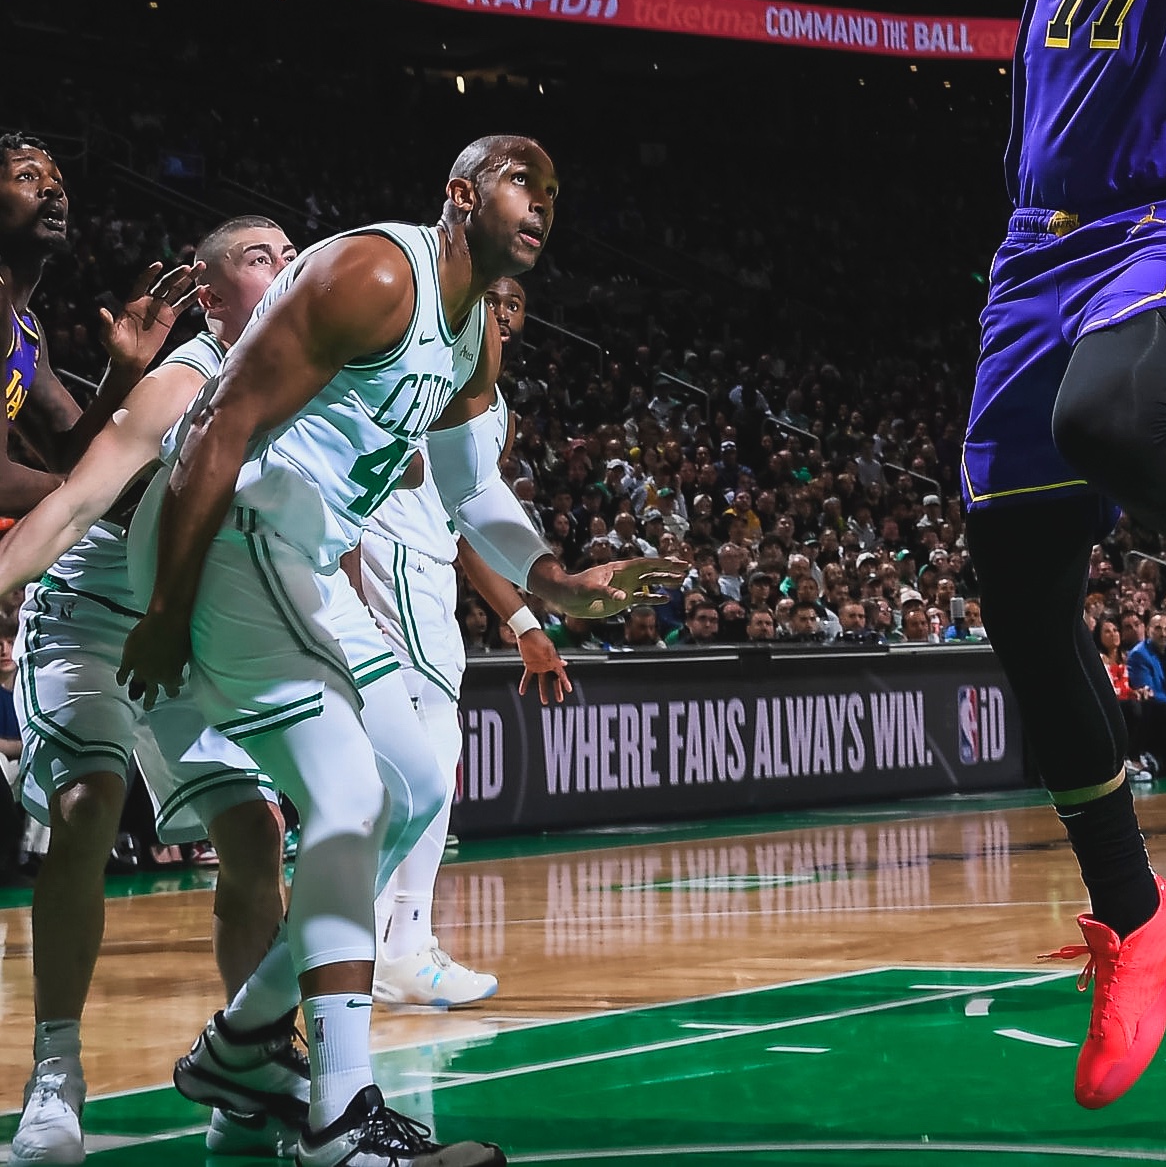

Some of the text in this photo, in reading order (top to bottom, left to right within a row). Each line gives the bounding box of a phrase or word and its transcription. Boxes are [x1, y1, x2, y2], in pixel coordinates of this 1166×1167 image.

[765, 5, 878, 47] COMMAND
[881, 18, 908, 50] THE
[914, 22, 974, 52] BALL
[541, 702, 660, 794] WHERE
[667, 697, 746, 785] FANS
[753, 691, 867, 778] ALWAYS
[870, 689, 933, 769] WIN.
